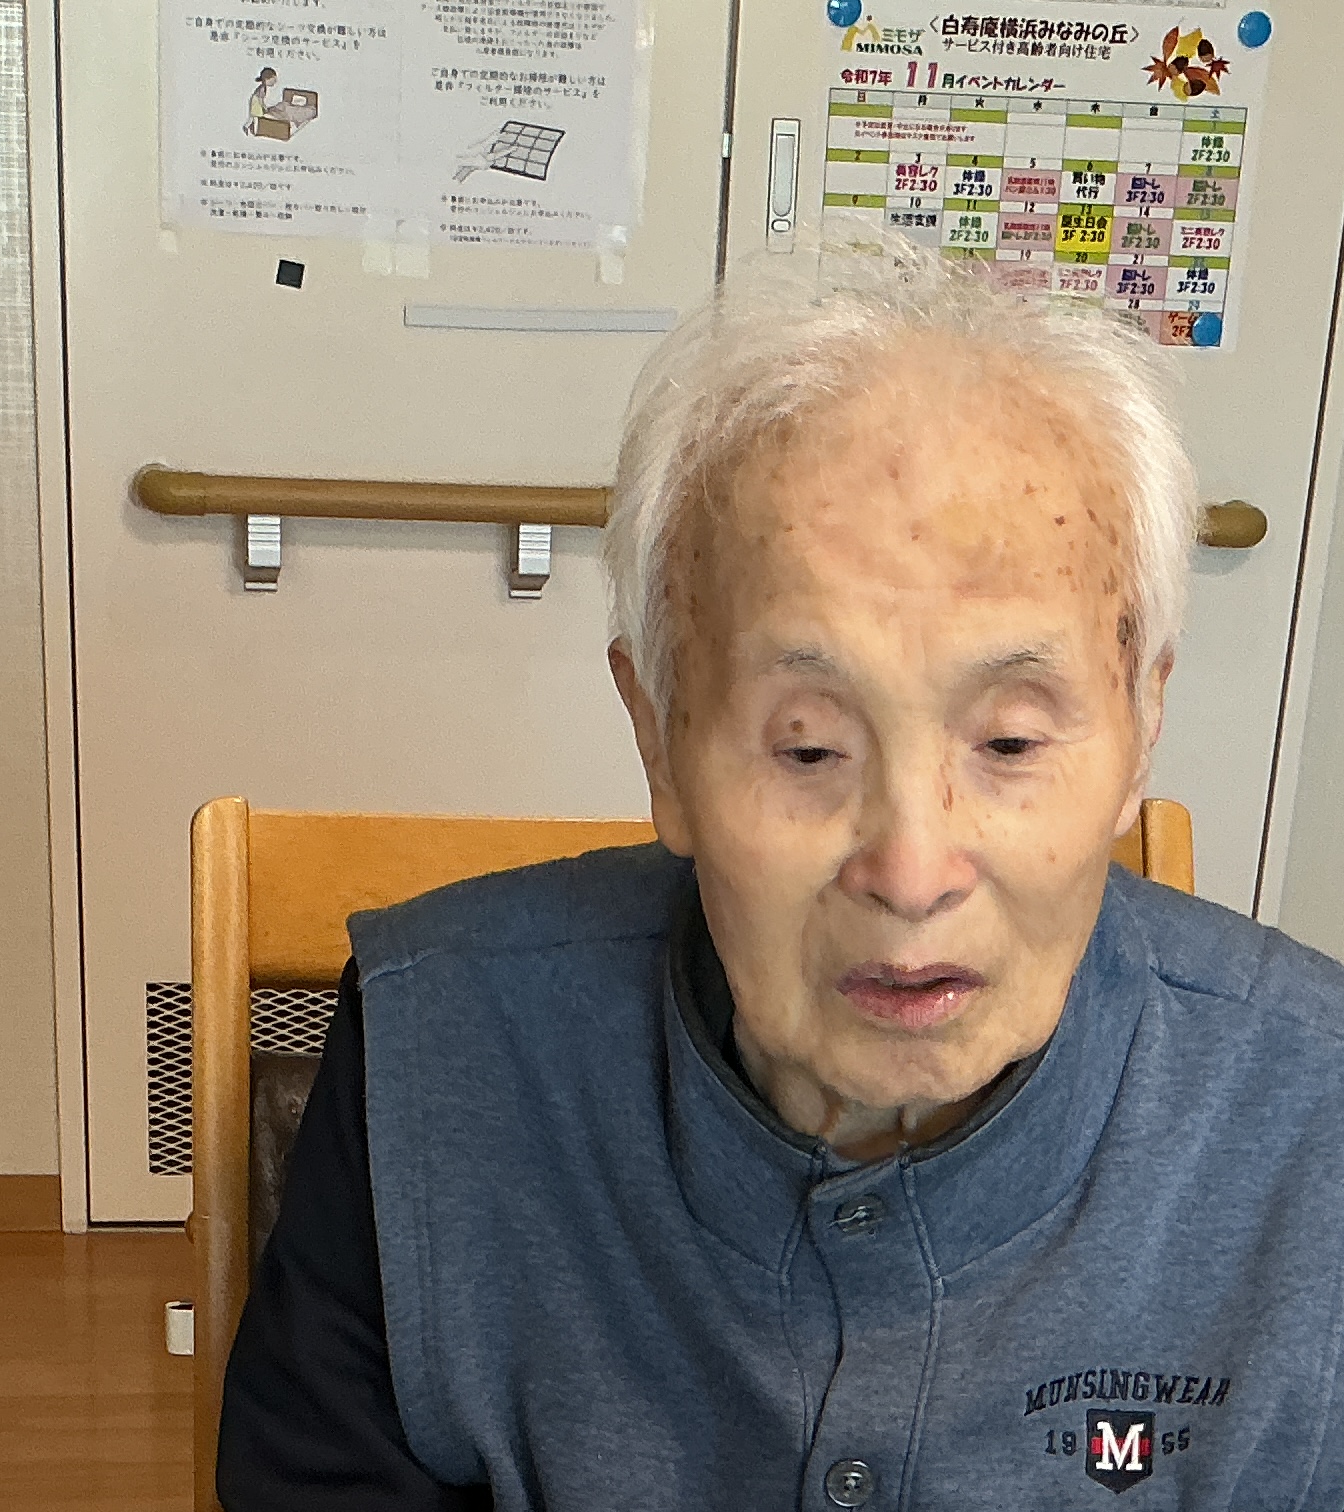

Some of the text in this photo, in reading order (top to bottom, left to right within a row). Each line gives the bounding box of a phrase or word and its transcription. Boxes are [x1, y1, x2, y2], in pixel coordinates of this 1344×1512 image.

[881, 27, 926, 43] ミモザ
[856, 43, 923, 56] MIMOSA
[941, 37, 1112, 60] サービス付き高齢者向け住宅
[840, 68, 893, 86] 令和7年
[857, 90, 866, 102] 日
[918, 94, 927, 106] 月
[1091, 102, 1101, 113] 木
[1030, 158, 1036, 169] 5
[895, 178, 938, 192] 2F2:30
[953, 183, 993, 197] 3F2:30
[1076, 186, 1100, 199] 代行
[910, 197, 921, 208] 10
[1024, 201, 1035, 213] 12
[1139, 206, 1150, 218] 14
[1060, 216, 1108, 229] 誕生日会
[949, 229, 989, 243] 2F2:30
[1061, 230, 1105, 243] 3F 2:30
[1075, 251, 1088, 263] 20
[1024, 1367, 1232, 1417] MUNSINGWEAR
[1045, 1420, 1192, 1472] 19 M 55
